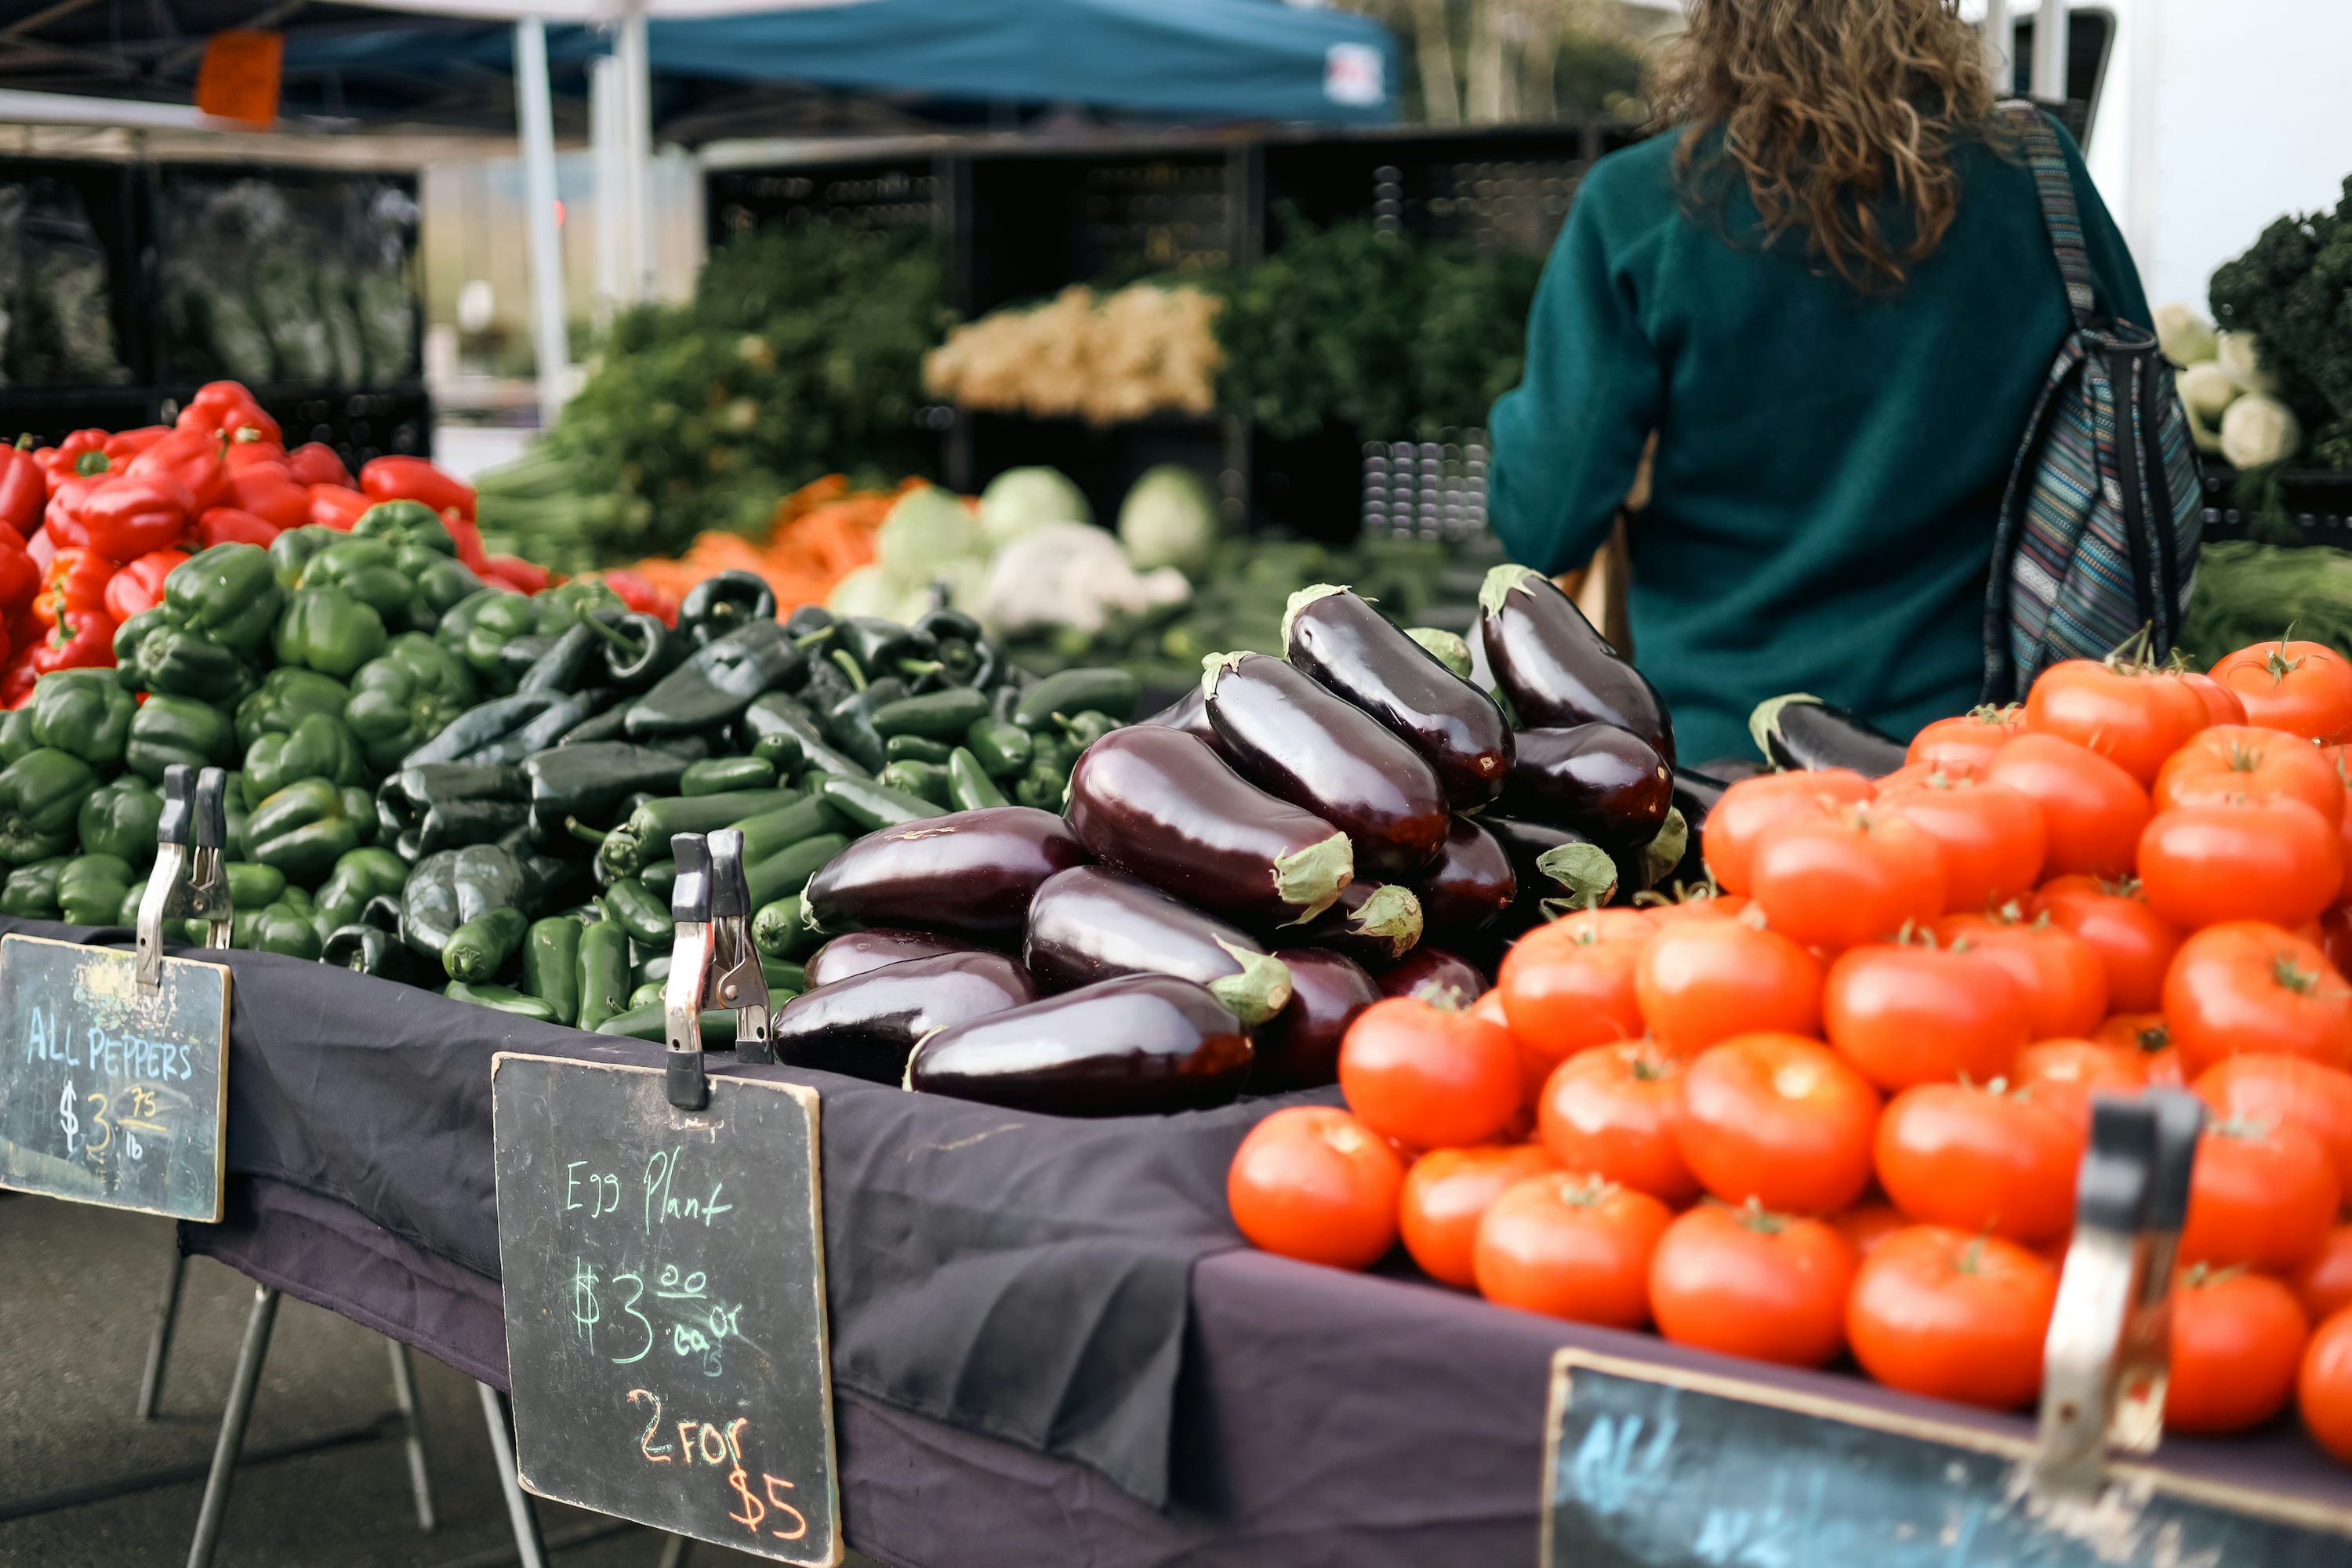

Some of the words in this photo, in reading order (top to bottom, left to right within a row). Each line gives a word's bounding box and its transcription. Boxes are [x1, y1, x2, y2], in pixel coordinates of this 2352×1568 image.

[27, 1005, 79, 1067] ALL
[88, 1027, 192, 1081] PEPPERS
[567, 1160, 619, 1219] Egg
[643, 1145, 733, 1236] Plant
[626, 1388, 674, 1462] 2
[729, 1463, 807, 1540] $5
